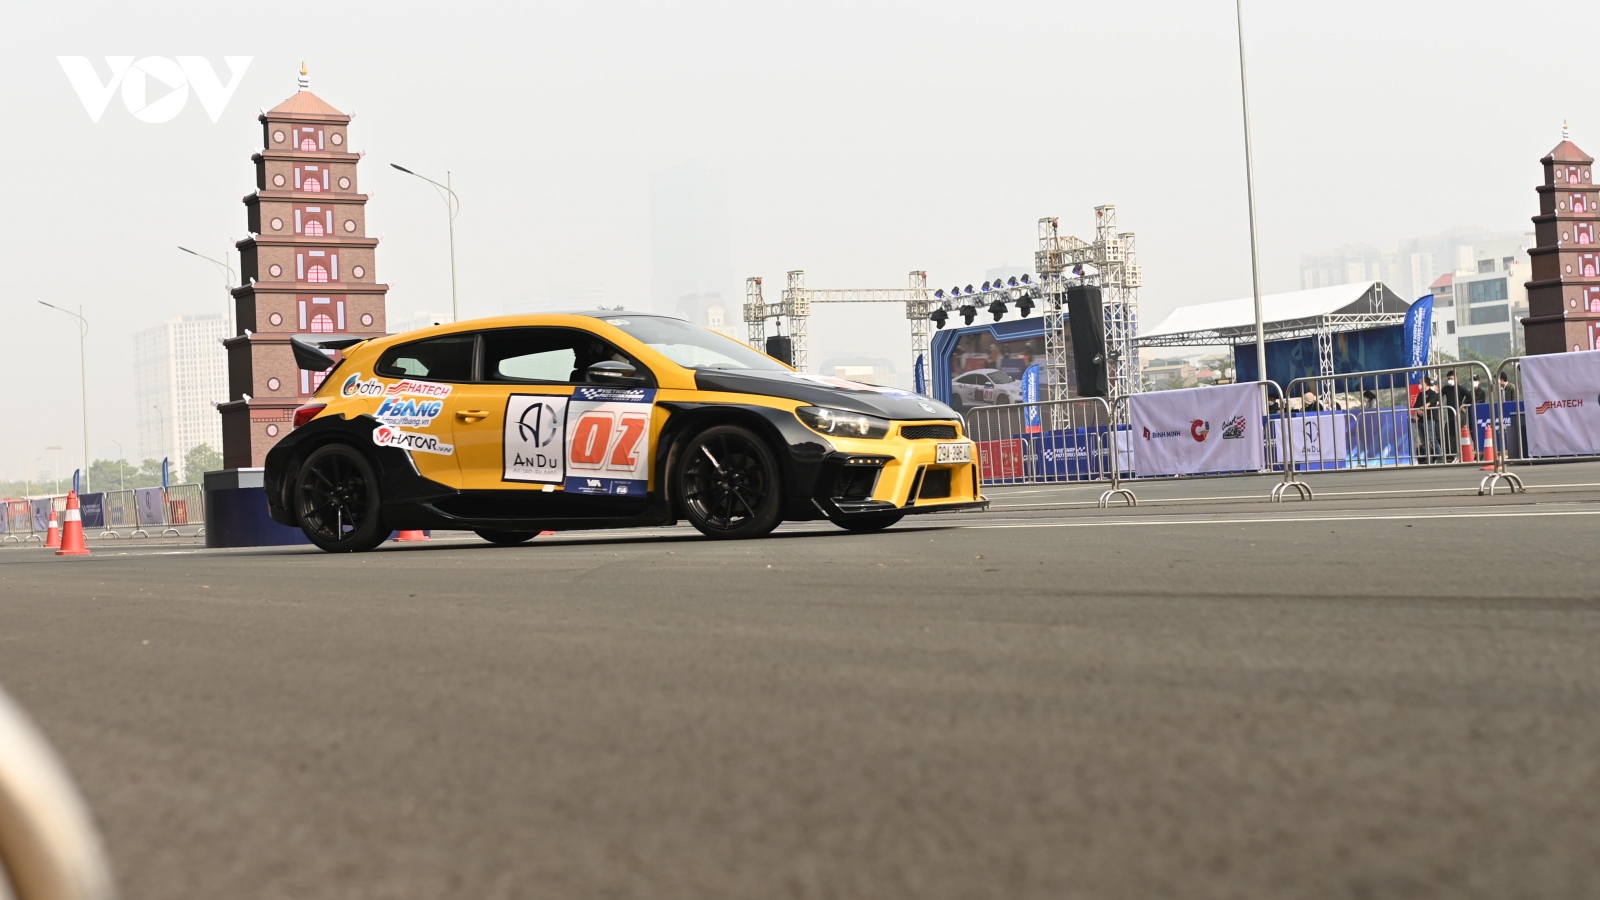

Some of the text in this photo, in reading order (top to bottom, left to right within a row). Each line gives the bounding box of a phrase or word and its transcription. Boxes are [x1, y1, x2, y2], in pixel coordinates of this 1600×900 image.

[407, 383, 450, 396] HATECH
[1550, 399, 1583, 408] HATECH
[1167, 430, 1181, 438] MINH
[568, 410, 649, 471] 02
